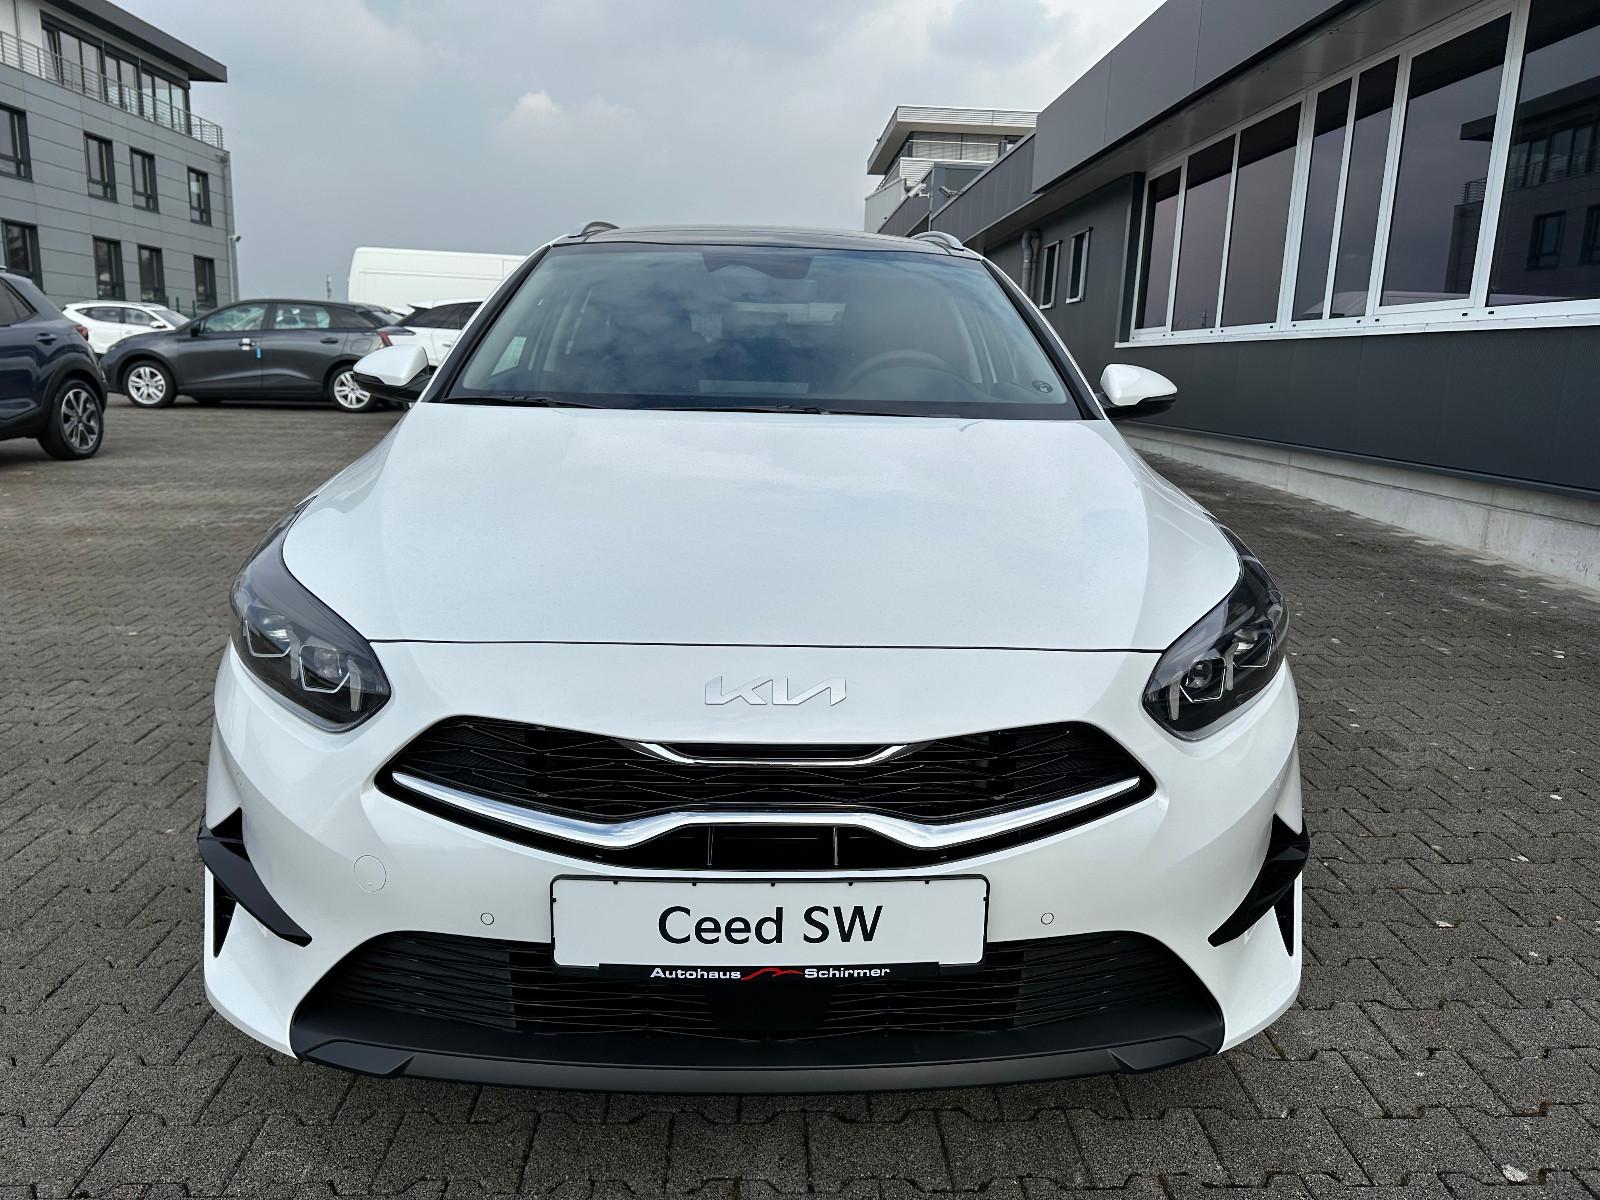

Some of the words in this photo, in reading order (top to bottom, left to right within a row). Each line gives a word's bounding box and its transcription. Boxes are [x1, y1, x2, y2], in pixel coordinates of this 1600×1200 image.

[704, 675, 847, 706] KIA
[658, 905, 784, 945] Ceed
[803, 905, 883, 944] SW
[650, 967, 741, 979] Autohaus
[804, 967, 890, 979] Schirmer
